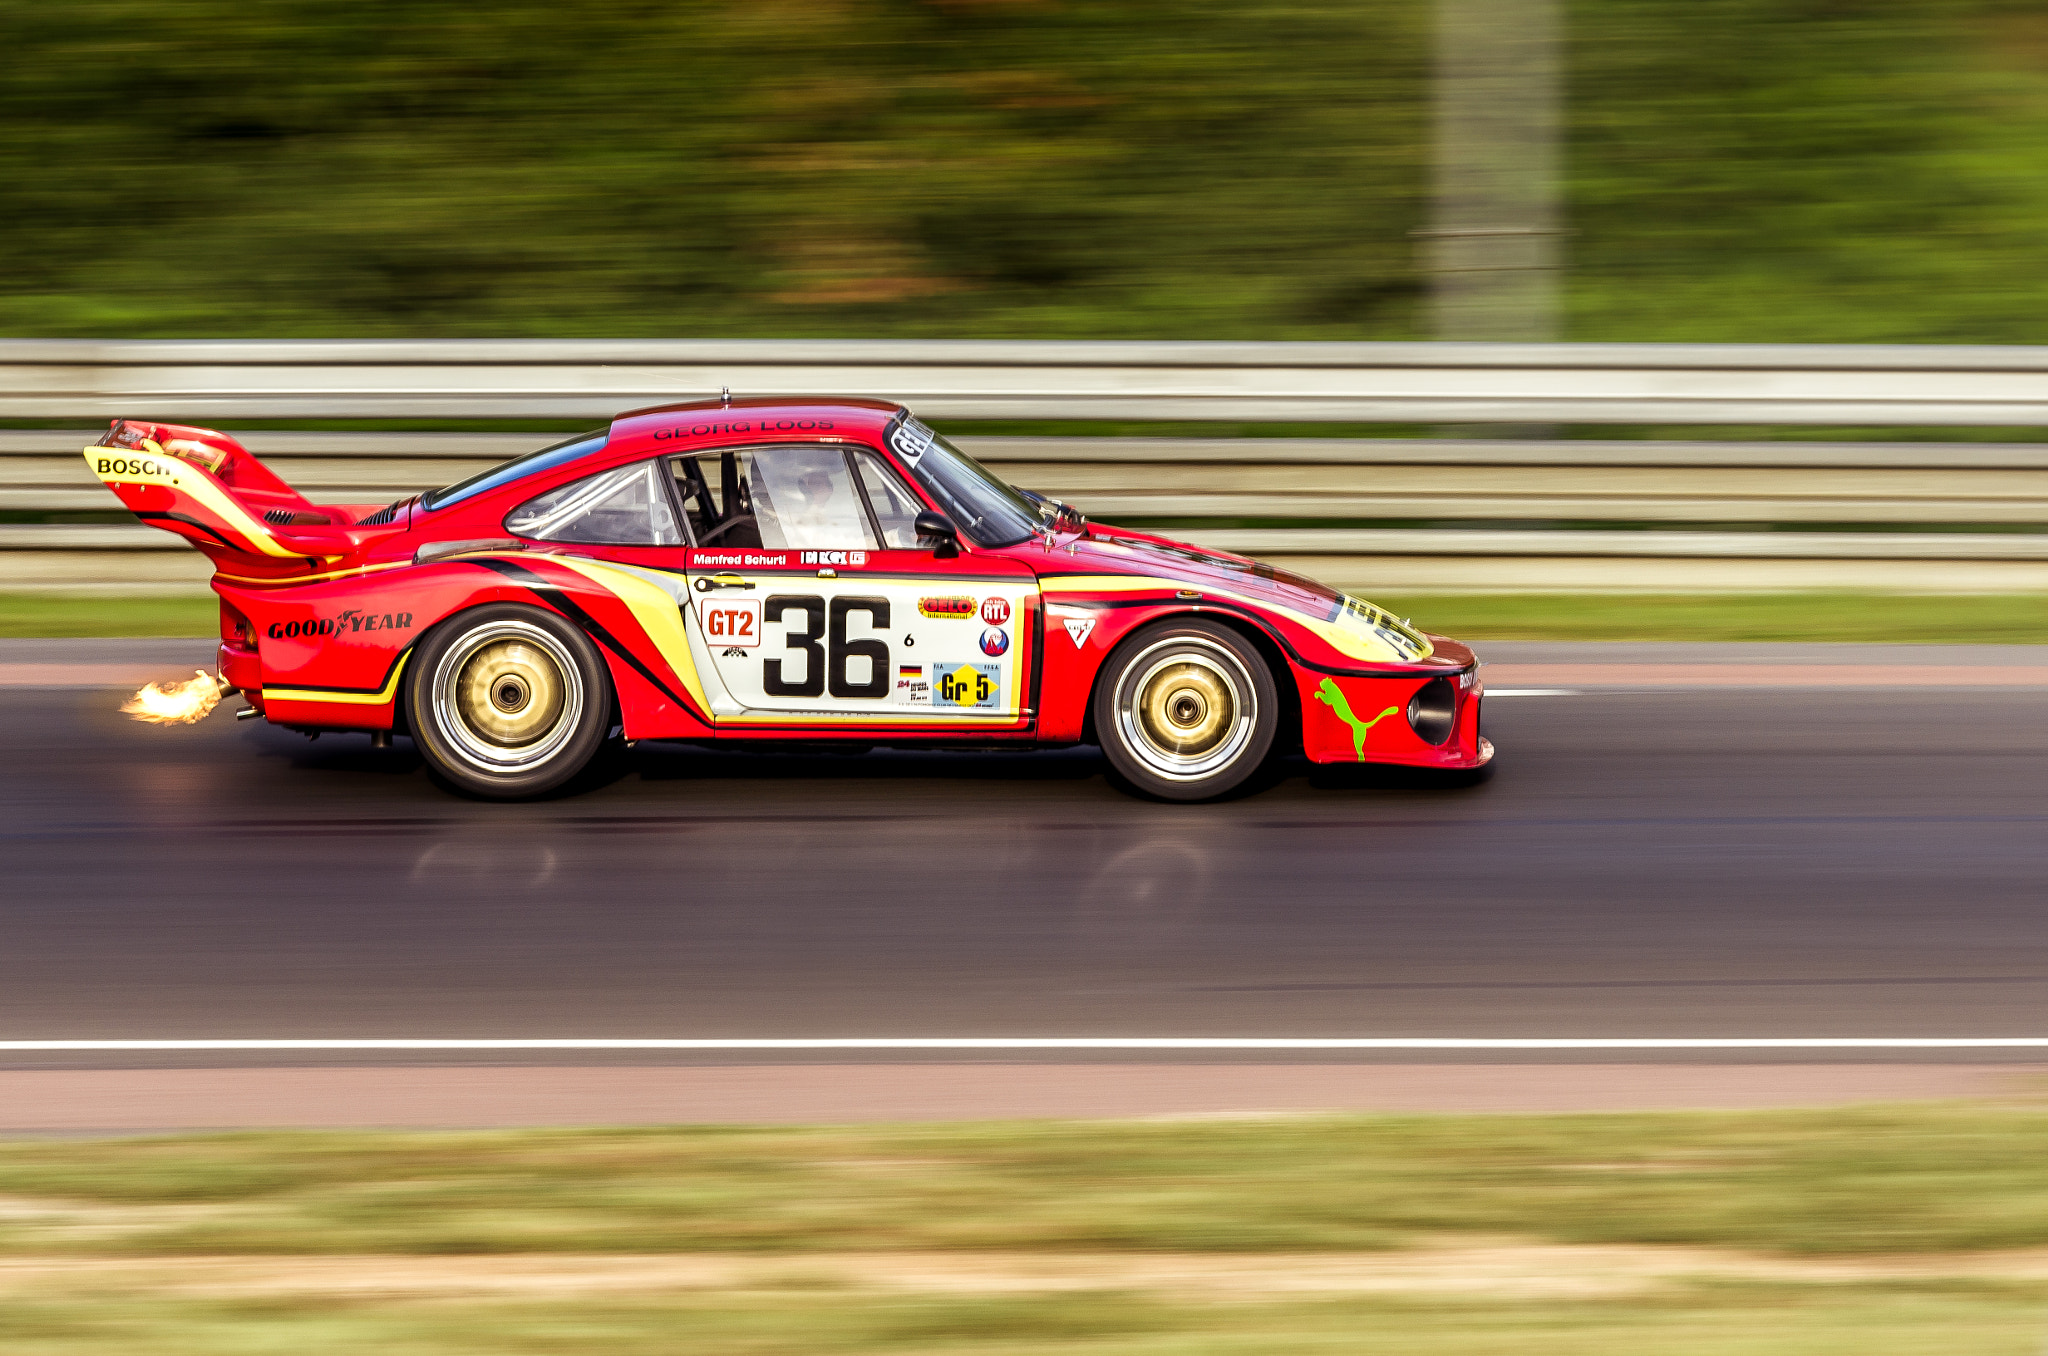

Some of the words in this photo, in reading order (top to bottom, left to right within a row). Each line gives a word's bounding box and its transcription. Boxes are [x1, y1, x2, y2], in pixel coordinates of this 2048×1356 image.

[653, 422, 750, 441] GEORG
[760, 420, 834, 432] LOOS
[97, 458, 170, 475] BOSCH
[693, 554, 742, 566] Manfred
[983, 603, 1008, 620] RTL
[708, 609, 753, 636] GT2
[763, 594, 891, 700] 36
[903, 633, 915, 647] 6
[941, 673, 968, 701] Gr
[976, 673, 989, 701] 5
